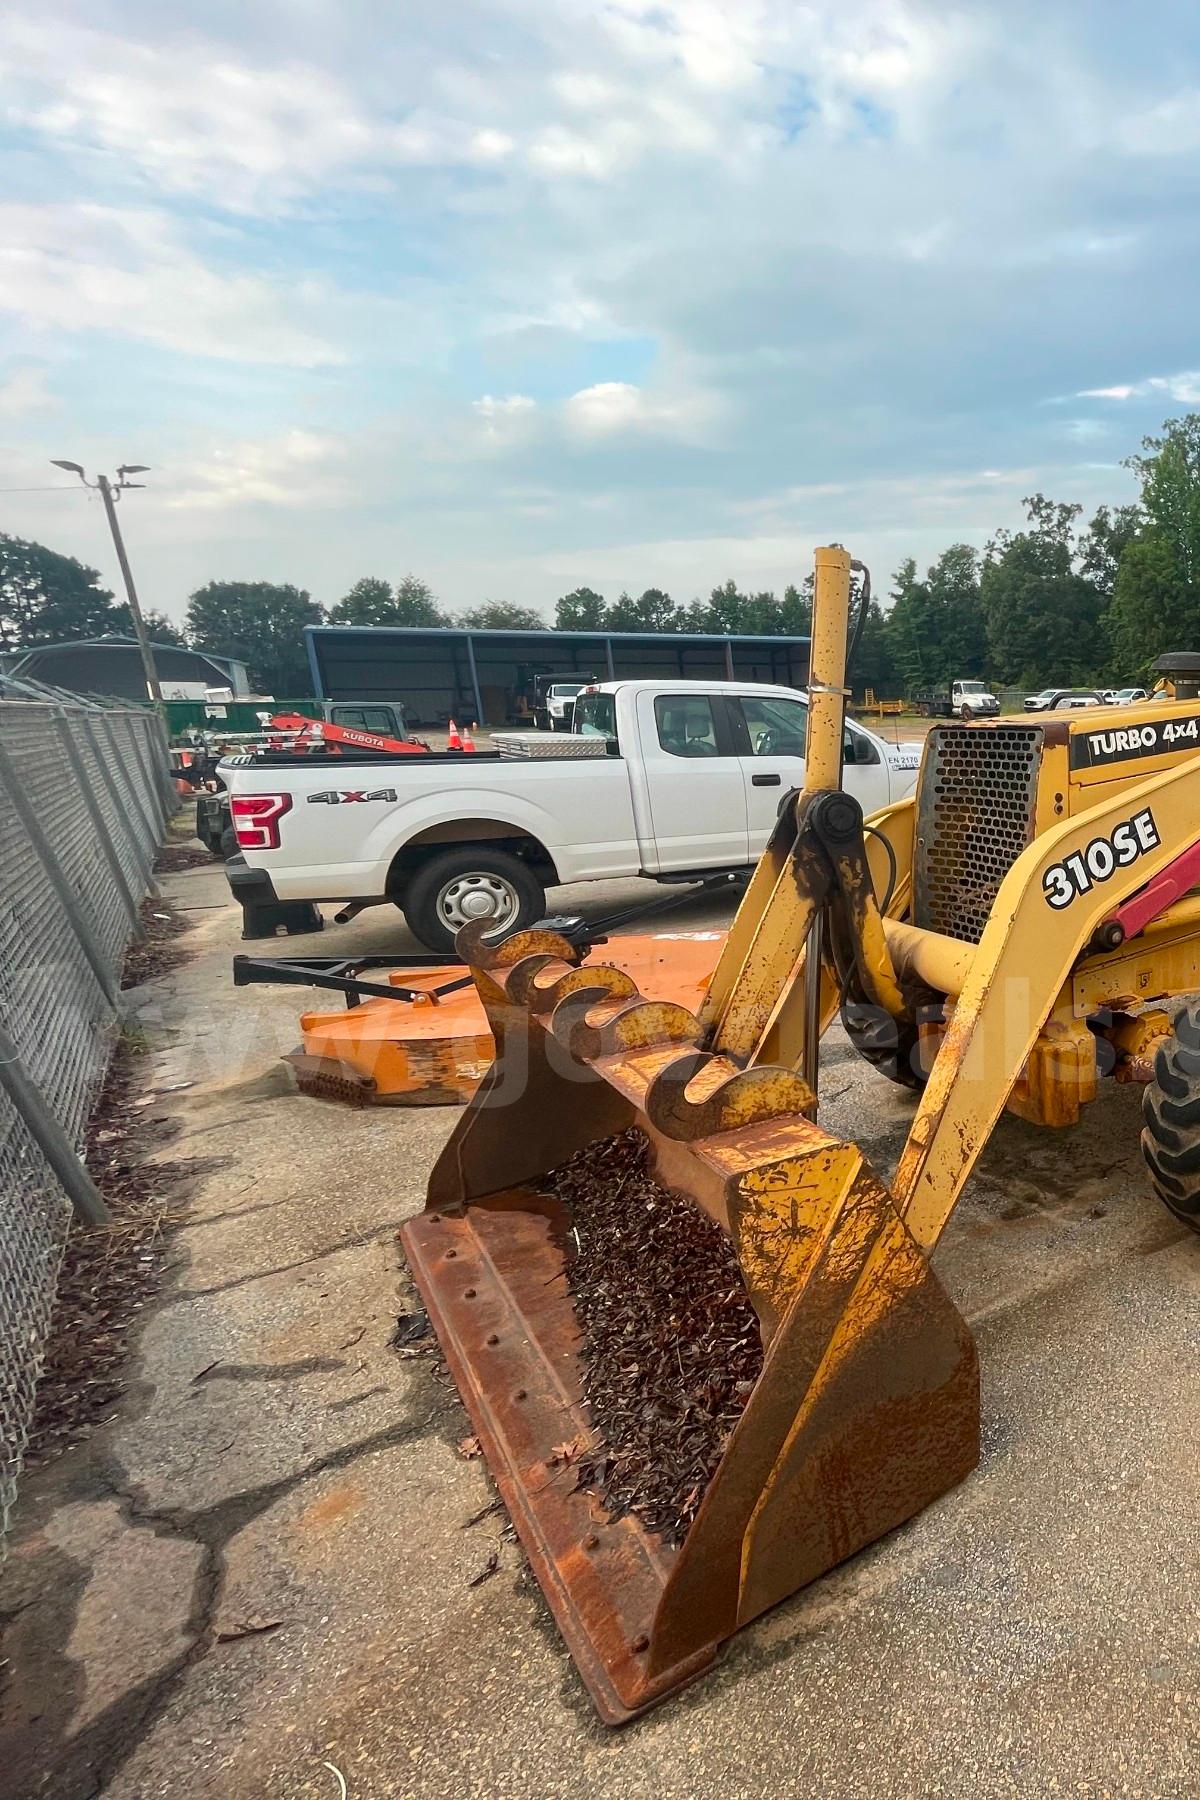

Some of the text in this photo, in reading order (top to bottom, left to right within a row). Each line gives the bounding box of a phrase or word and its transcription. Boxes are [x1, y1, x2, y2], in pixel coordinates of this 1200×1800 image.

[342, 731, 384, 748] KUBOTA
[1088, 720, 1199, 756] TURBO 4x4
[1042, 806, 1161, 910] 310SE
